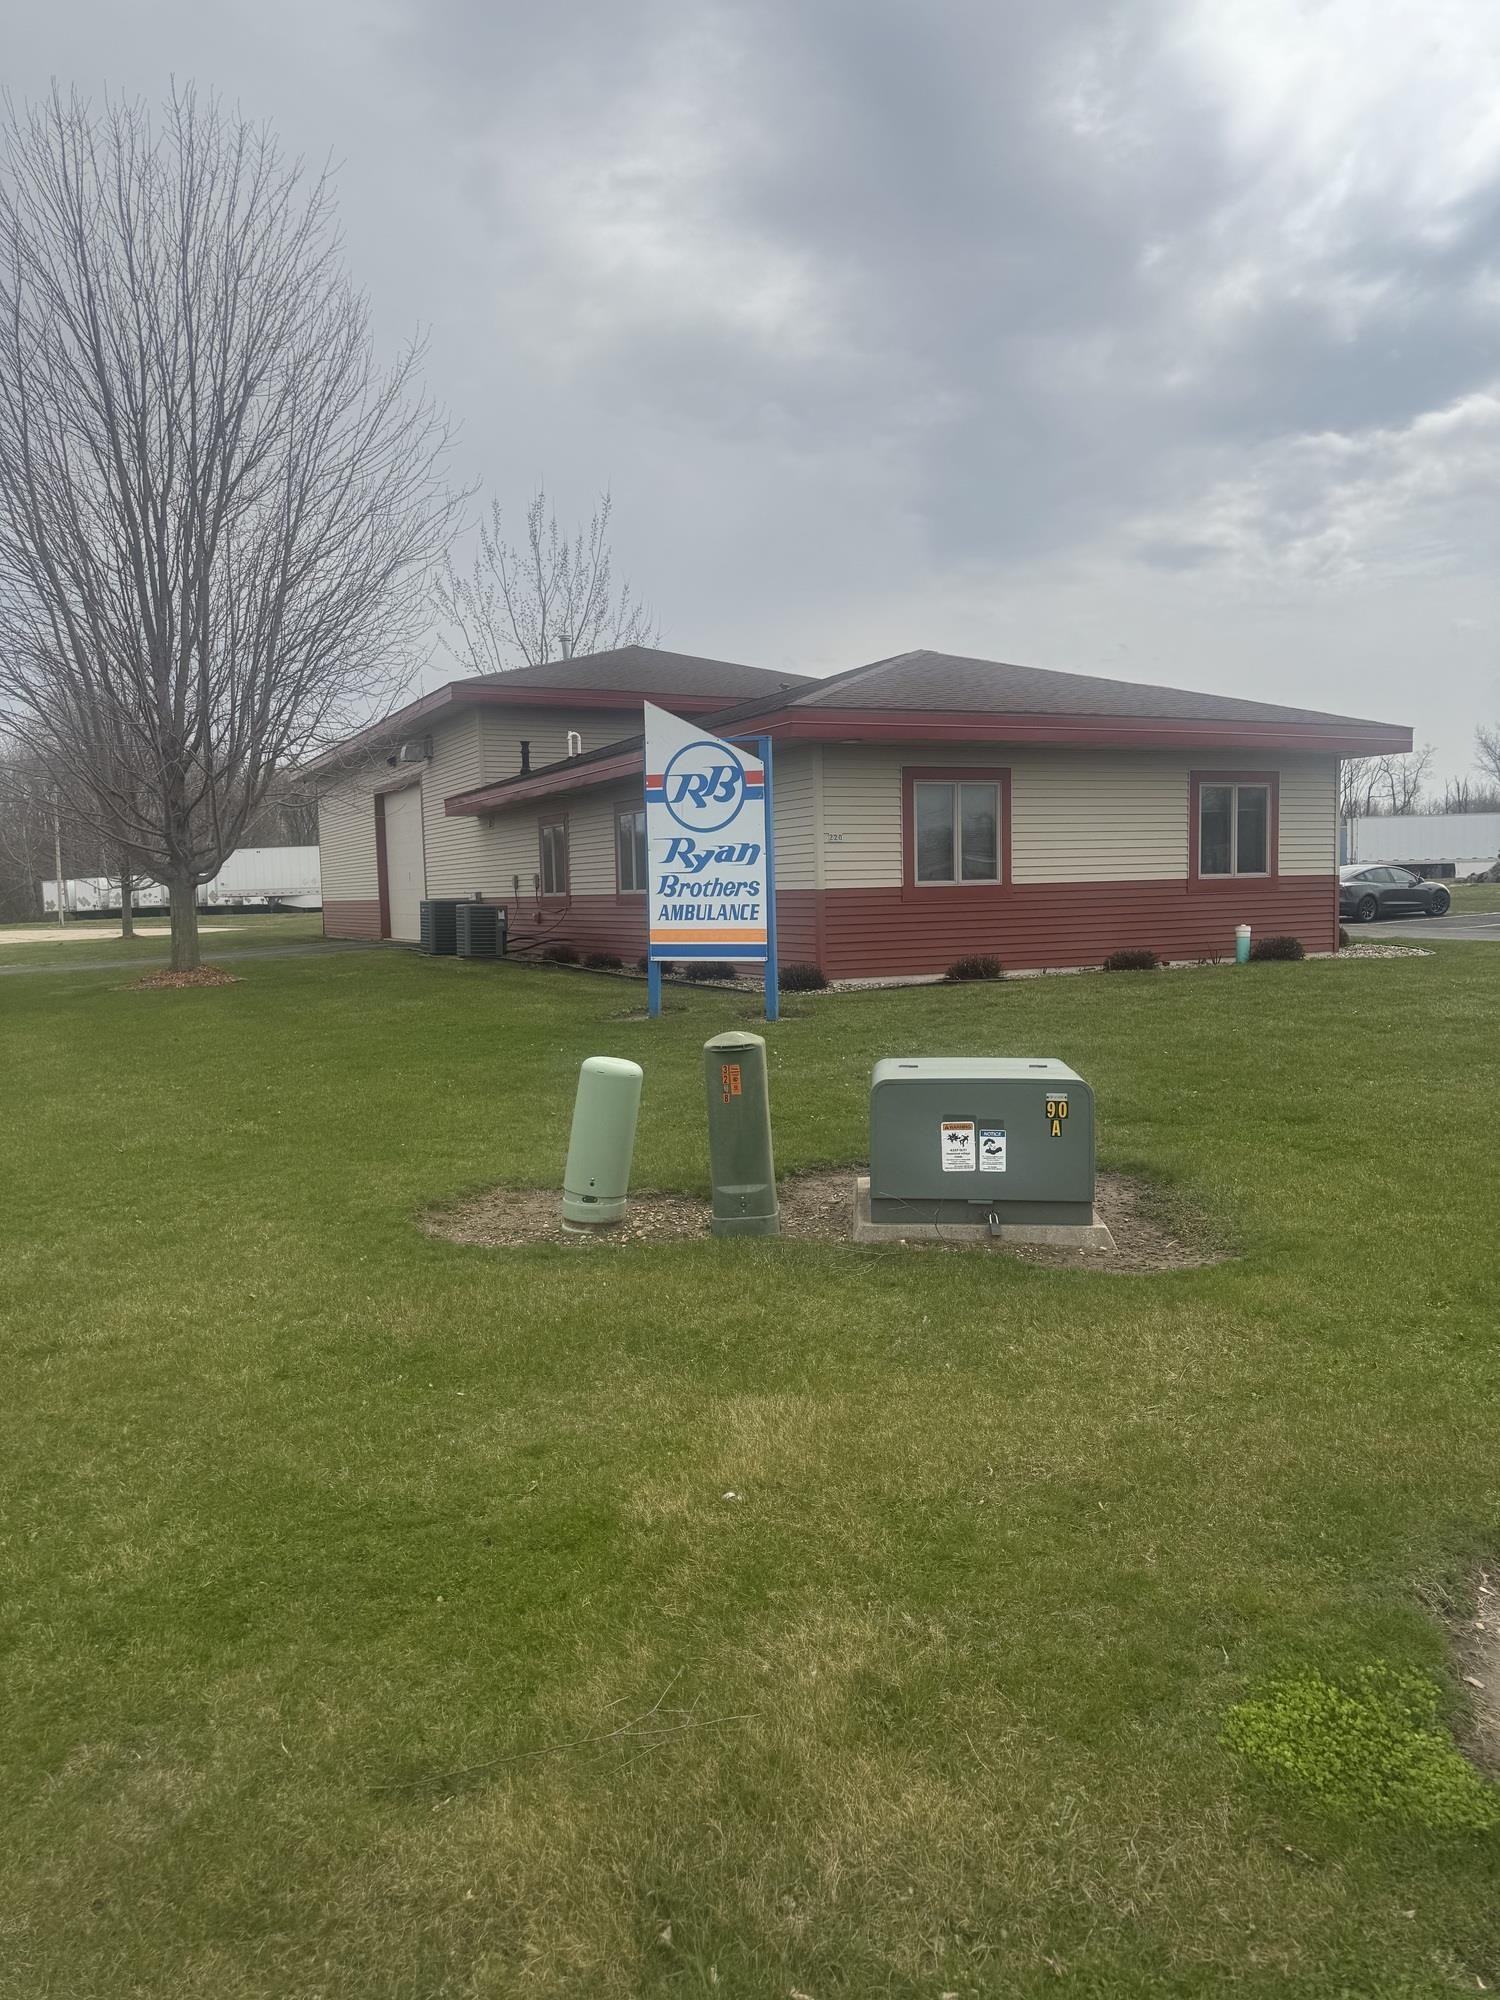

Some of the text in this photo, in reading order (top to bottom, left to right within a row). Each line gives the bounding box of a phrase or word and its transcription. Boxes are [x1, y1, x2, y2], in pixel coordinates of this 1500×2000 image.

[667, 765, 742, 809] RB
[654, 837, 762, 874] Ryan
[657, 875, 760, 898] Brothers
[657, 903, 760, 921] AMBULANCE
[1047, 1101, 1067, 1118] 90
[1052, 1119, 1061, 1137] A
